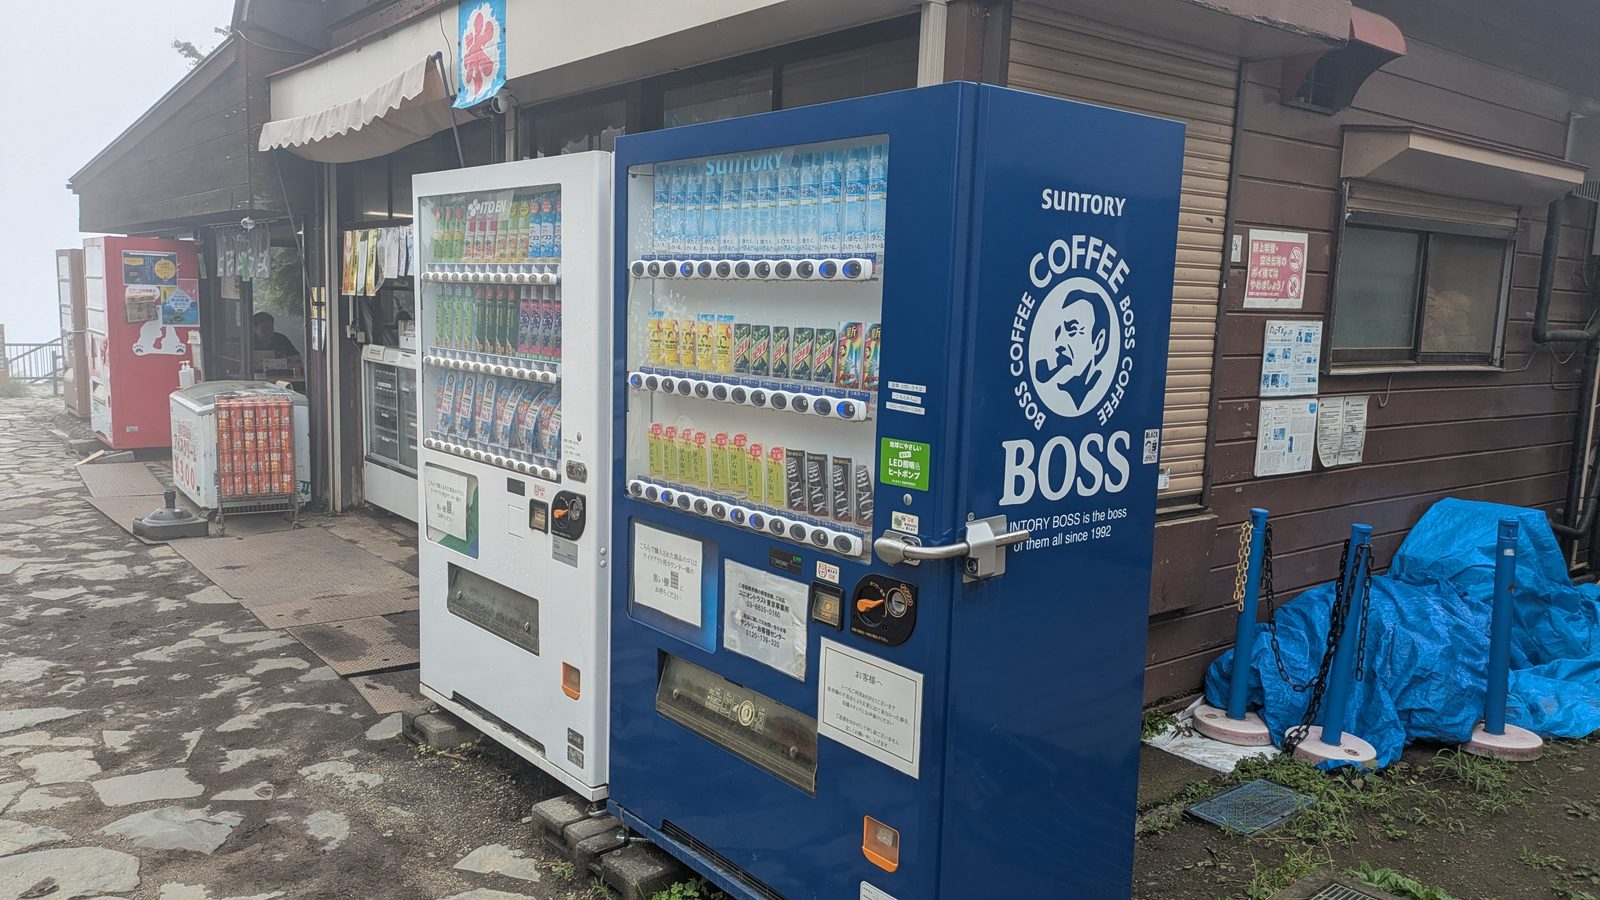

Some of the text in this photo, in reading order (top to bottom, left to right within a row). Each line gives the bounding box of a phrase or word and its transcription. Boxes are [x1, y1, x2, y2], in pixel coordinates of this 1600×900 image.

[480, 199, 507, 214] ITO EN
[1041, 188, 1126, 217] SUNTORY
[1029, 235, 1130, 294] COFFEE
[1010, 291, 1046, 431] BOSS COFFEE
[1097, 295, 1136, 426] BOSS COFFEE
[787, 460, 804, 507] BLACK
[808, 464, 826, 513] BLACK
[888, 468, 920, 480] ヒートポンプ
[999, 430, 1130, 506] BOSS
[833, 468, 849, 517] BLACK
[1025, 536, 1050, 550] them
[1052, 533, 1063, 545] all
[1065, 532, 1088, 544] since
[1091, 525, 1112, 540] 1992
[1052, 512, 1081, 529] BOSS
[1082, 512, 1090, 523] is
[1092, 510, 1106, 522] the
[1108, 507, 1127, 520] boss
[855, 669, 883, 686] お客様へ
